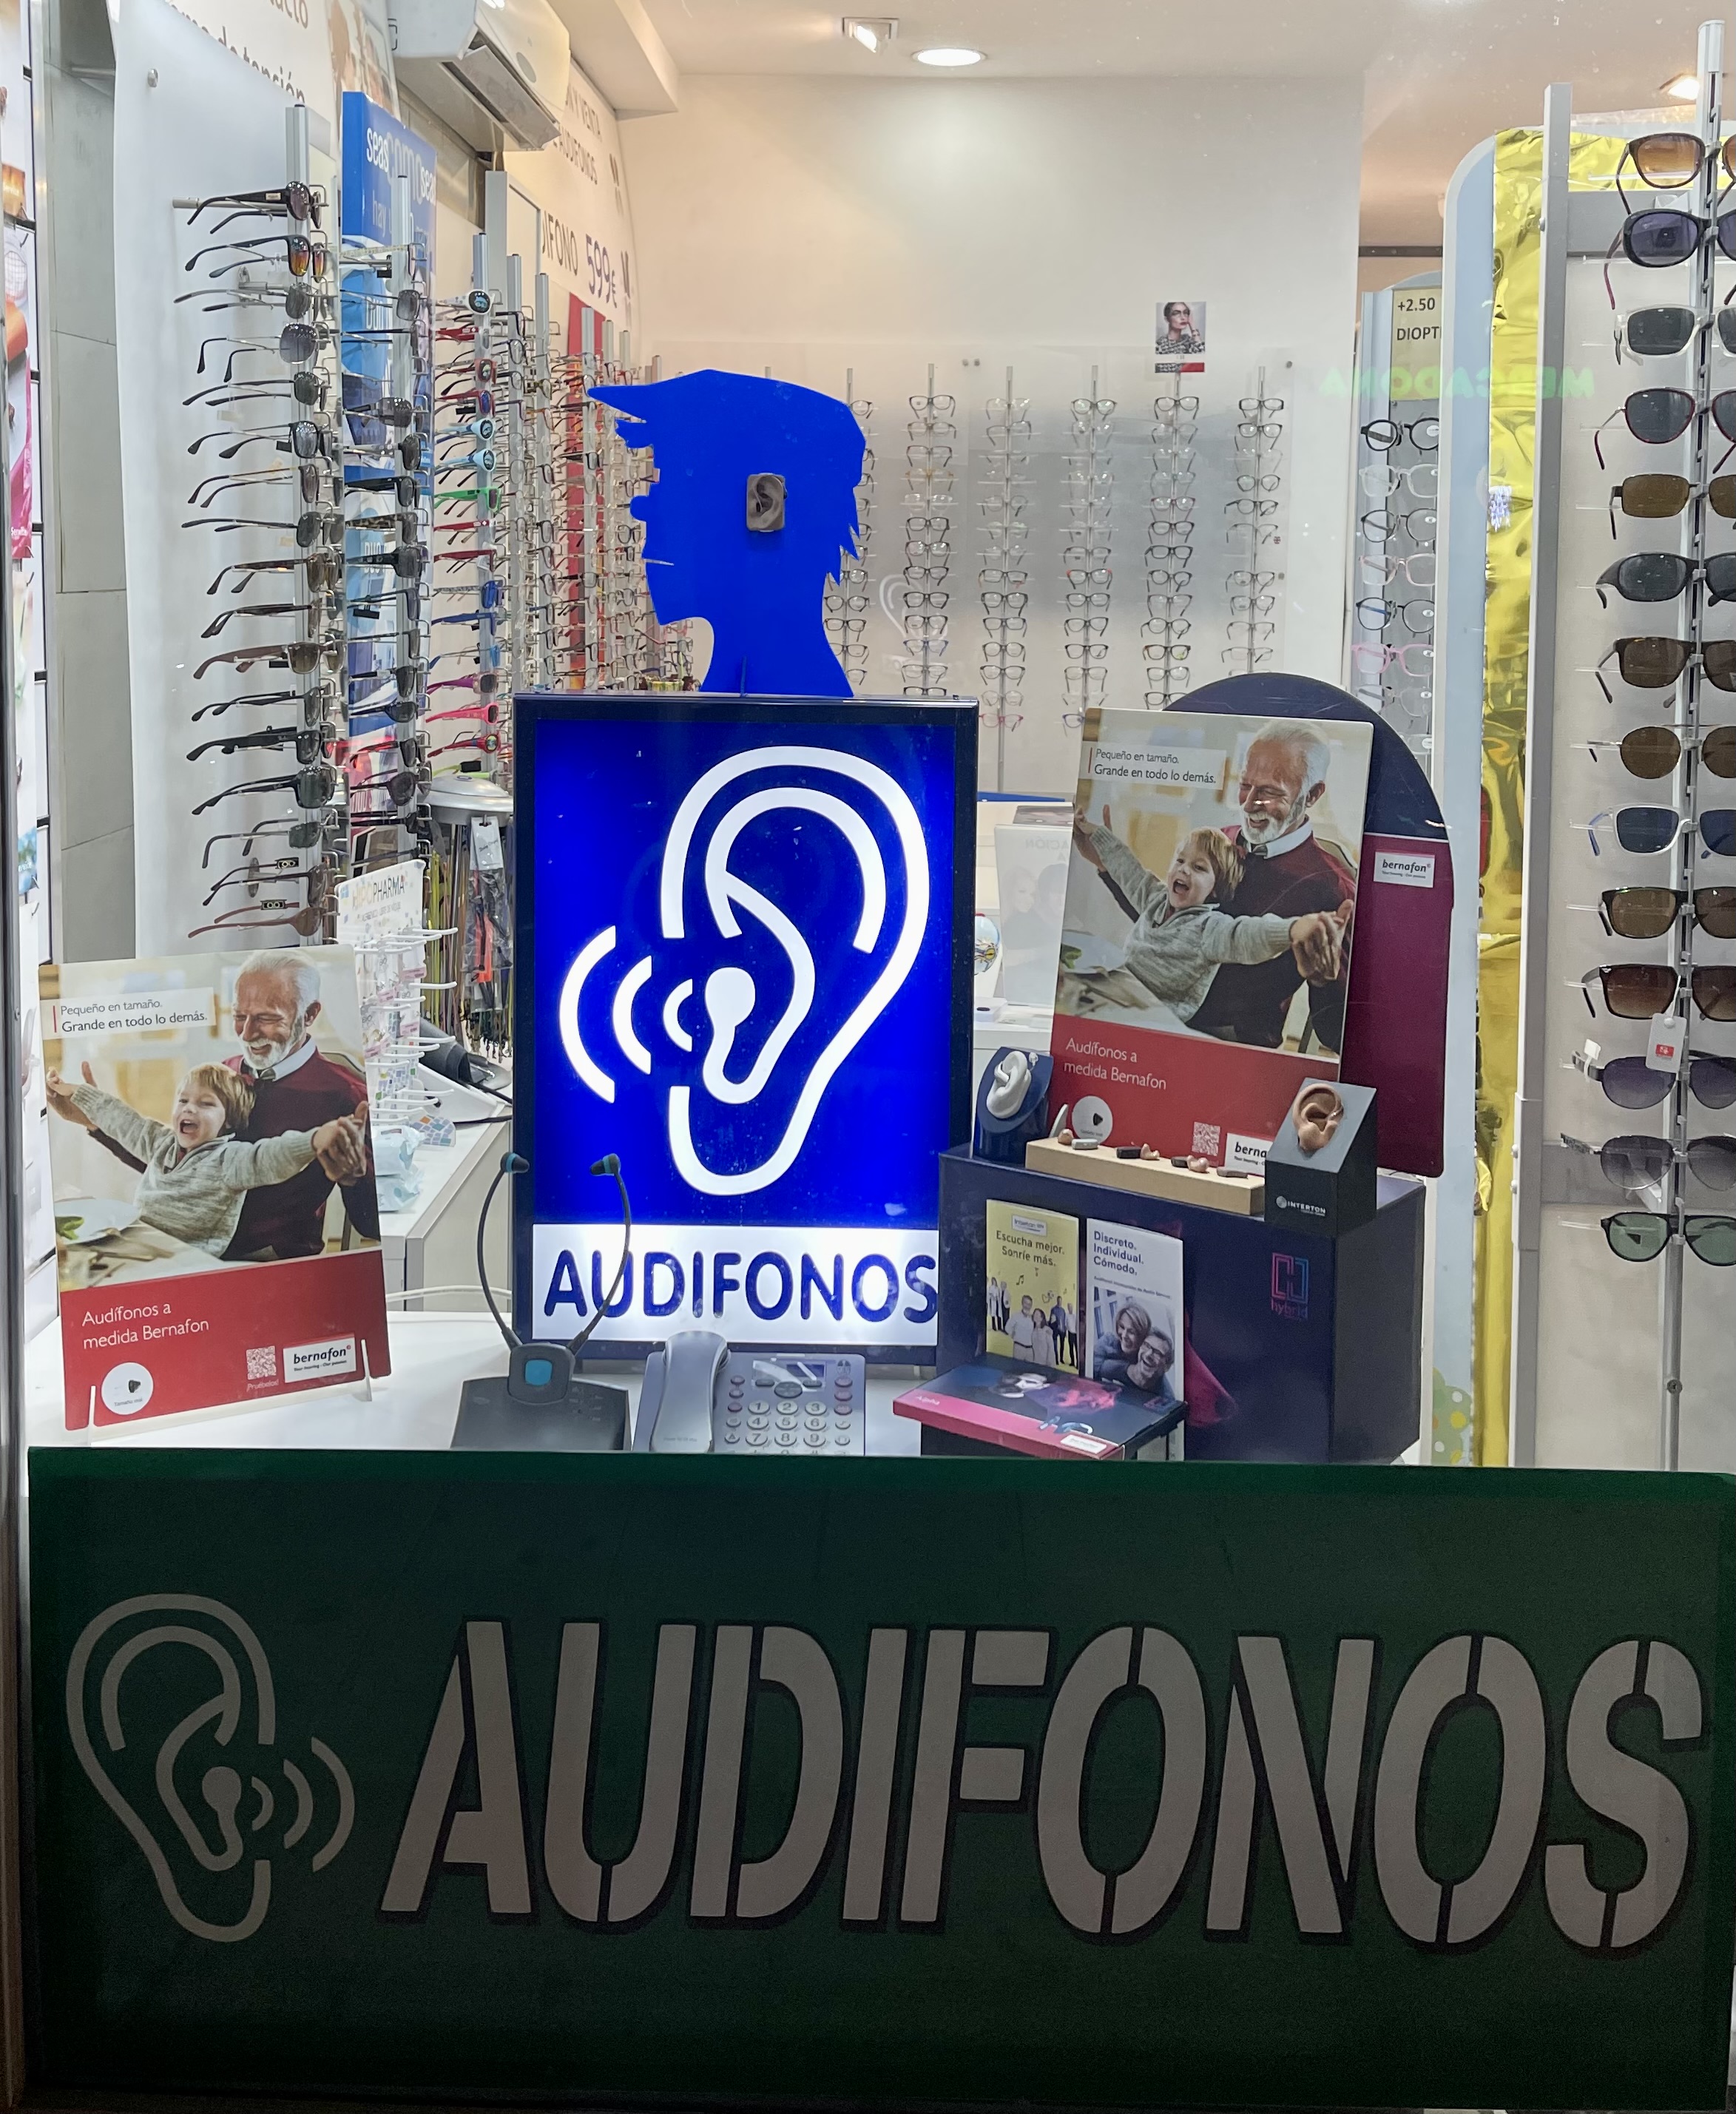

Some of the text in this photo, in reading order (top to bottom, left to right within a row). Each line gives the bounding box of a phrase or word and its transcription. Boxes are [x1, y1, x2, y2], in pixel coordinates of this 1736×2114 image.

[366, 127, 389, 173] seas
[1397, 297, 1436, 311] +2.50
[1397, 326, 1442, 340] DIOPT
[1095, 749, 1179, 764] Pequeño en tamaño.
[1095, 763, 1217, 784] Grande en todo lo demás.
[1382, 859, 1427, 873] bernafon
[61, 999, 163, 1016] Pequeño en tamaño.
[62, 1010, 208, 1033] Grande en todo lo demás.
[1065, 1037, 1138, 1063] Audífonos a
[1064, 1062, 1166, 1090] medida Bernafon
[1287, 1200, 1325, 1214] INTERTON
[996, 1229, 1065, 1255] Escucha mejor.
[1094, 1230, 1137, 1251] Discreto.
[1002, 1245, 1056, 1267] Sonríe más.
[1093, 1243, 1144, 1265] Individual.
[544, 1249, 939, 1324] AUDIFONOS
[81, 1303, 172, 1327] Audífonos a
[83, 1318, 210, 1350] medida Bernafon
[294, 1346, 347, 1365] bernafon
[782, 1402, 791, 1411] 2
[811, 1402, 820, 1411] 3
[752, 1417, 820, 1427] 4 5 6
[752, 1433, 820, 1442] 7 8 9
[379, 1619, 1703, 1949] AUDIFONOS
